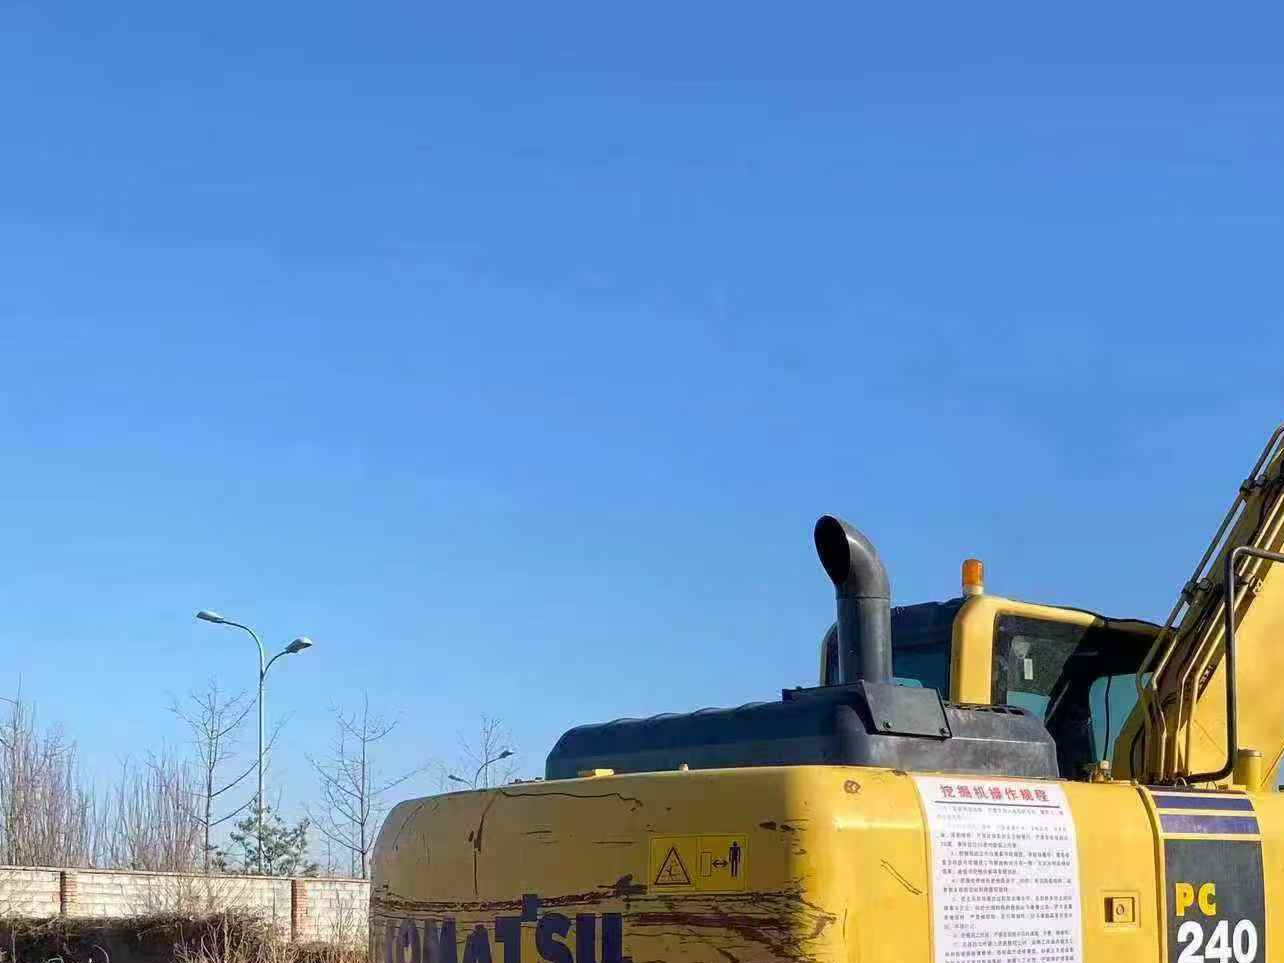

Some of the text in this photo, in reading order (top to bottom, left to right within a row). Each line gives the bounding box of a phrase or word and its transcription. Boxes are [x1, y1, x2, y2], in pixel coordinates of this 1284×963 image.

[939, 783, 1049, 802] 挖掘机操作规程
[1175, 882, 1216, 916] PC
